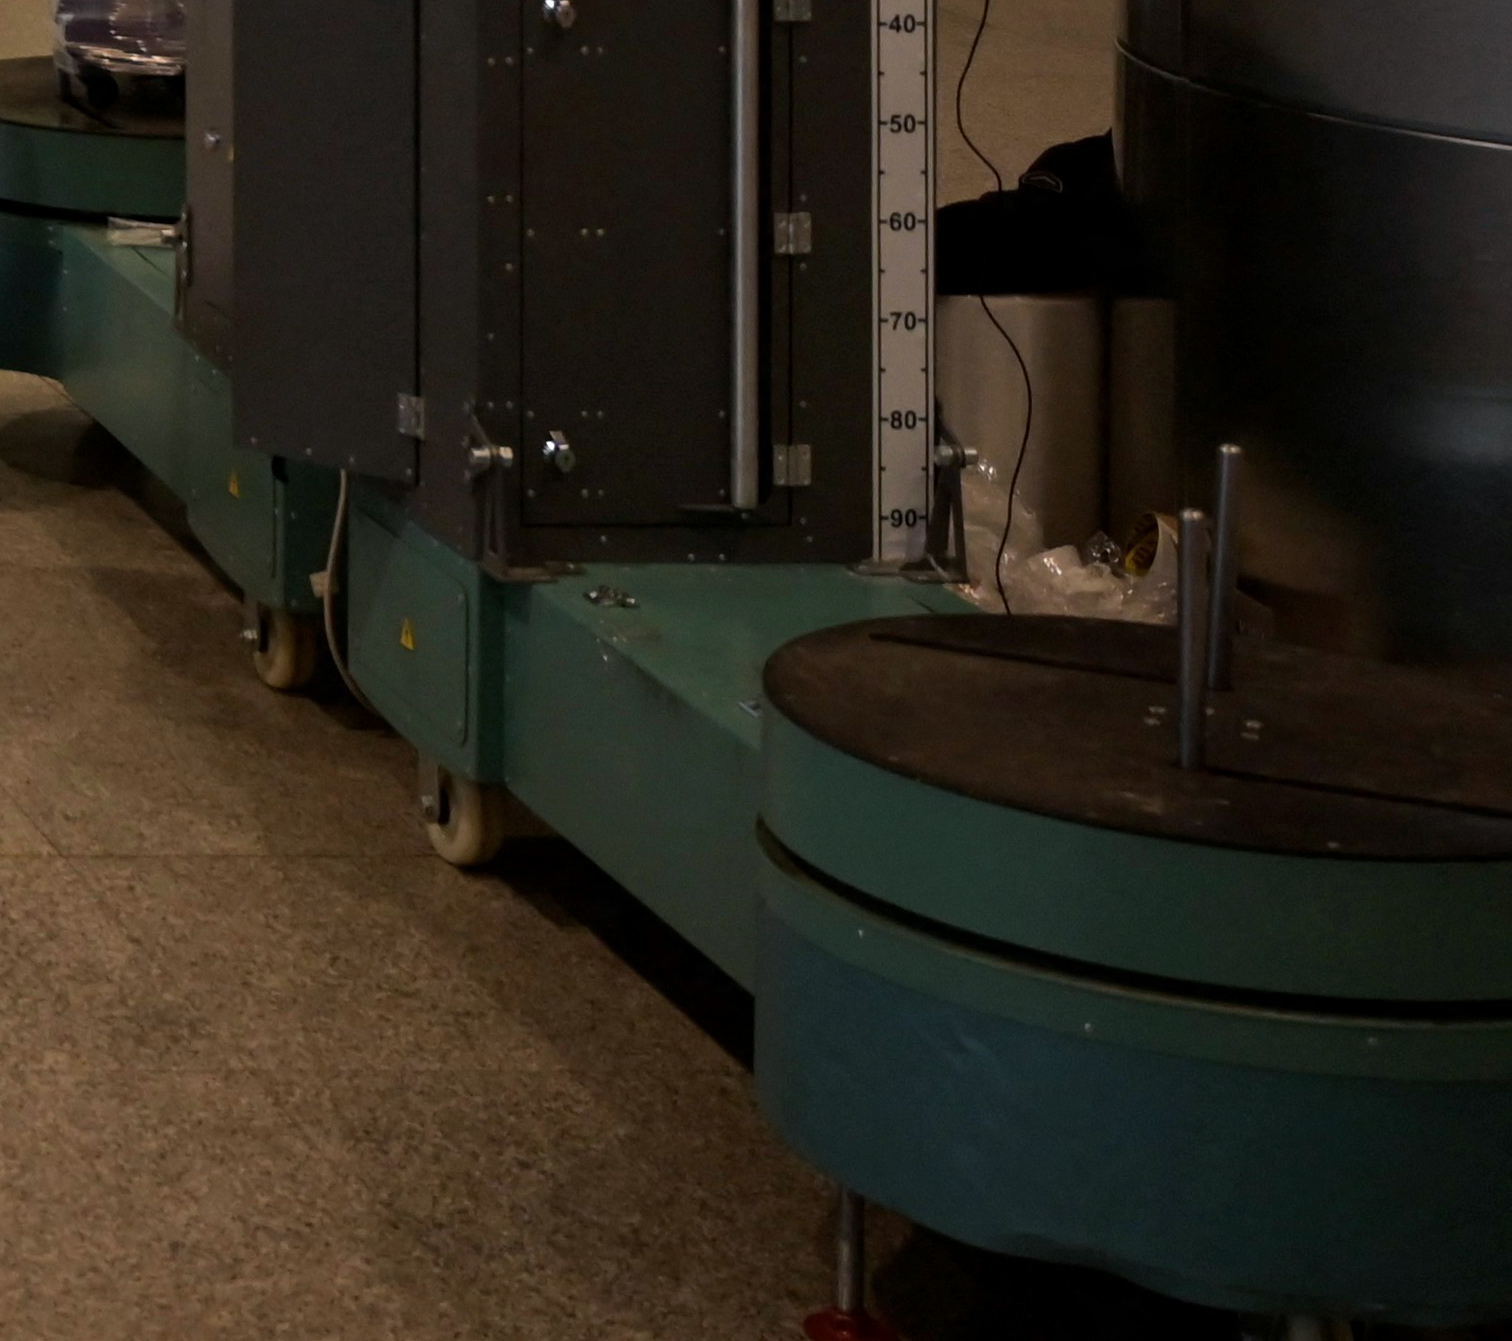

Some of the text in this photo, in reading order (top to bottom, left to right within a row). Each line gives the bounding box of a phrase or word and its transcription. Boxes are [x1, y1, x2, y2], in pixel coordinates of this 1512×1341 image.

[889, 13, 914, 34] 40
[889, 113, 914, 133] 50
[889, 211, 914, 231] 60
[889, 310, 914, 331] 70
[889, 409, 914, 429] 80
[889, 508, 914, 528] 90
